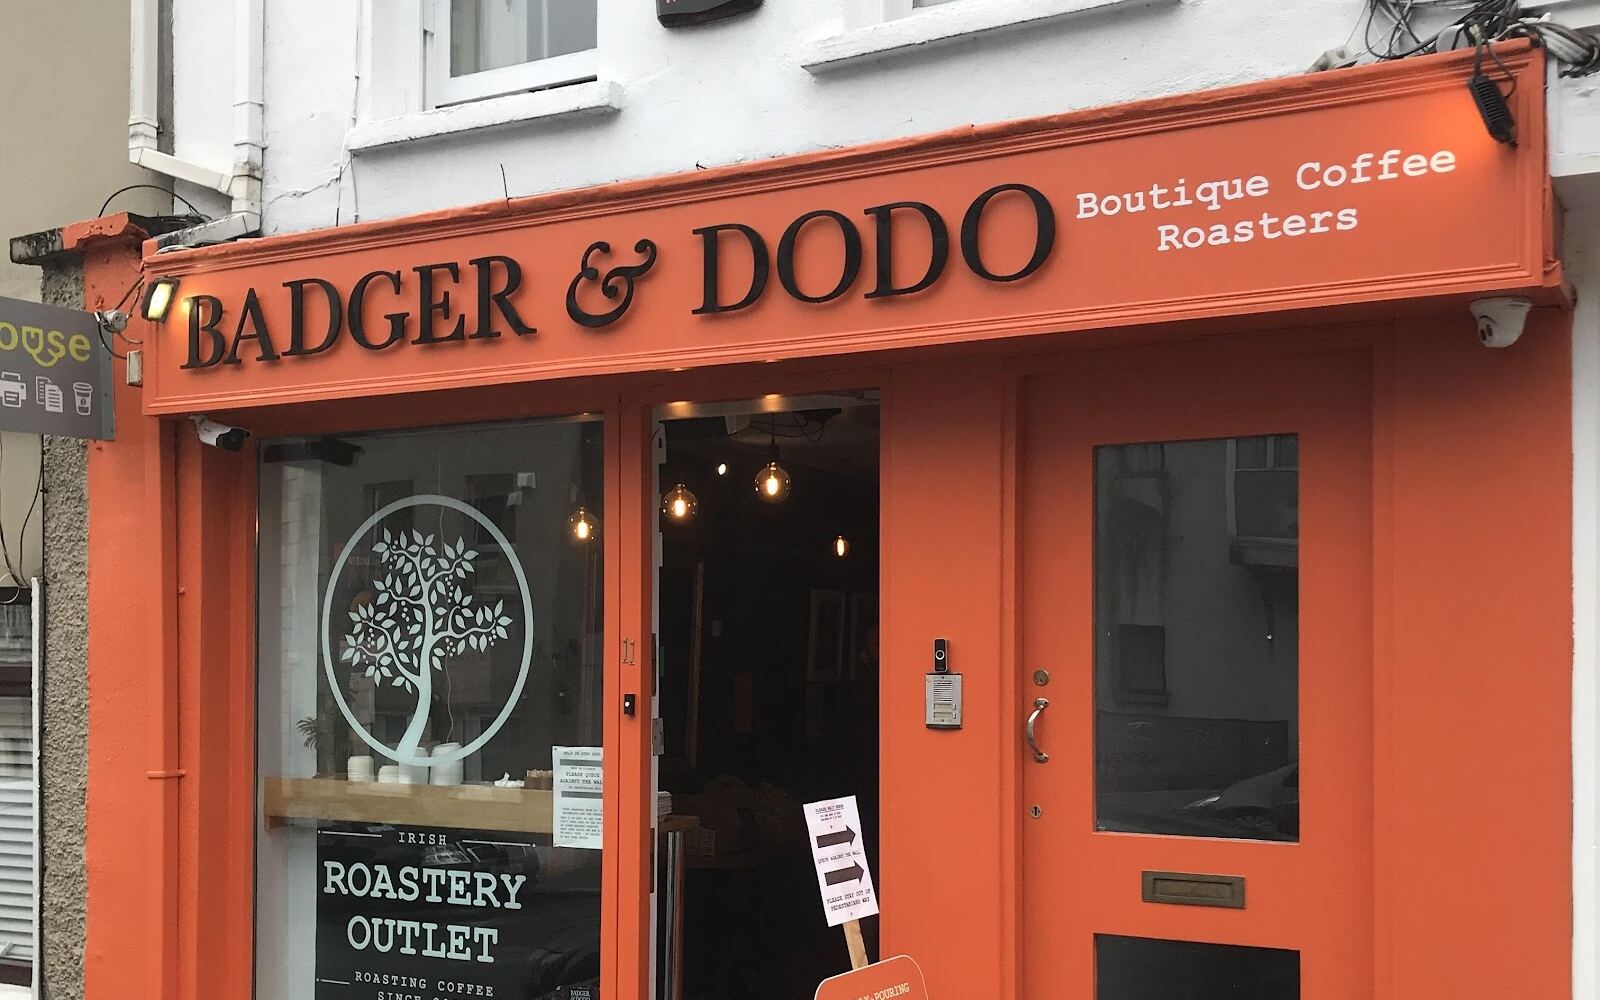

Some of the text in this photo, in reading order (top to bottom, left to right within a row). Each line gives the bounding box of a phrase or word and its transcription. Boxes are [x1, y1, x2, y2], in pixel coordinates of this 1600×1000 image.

[1076, 149, 1457, 219] Boutique Coffee
[1157, 208, 1358, 251] Roasters
[180, 183, 1056, 370] BADGER & DODO
[398, 831, 447, 845] IRISH
[323, 860, 527, 910] ROASTERY
[827, 896, 842, 904] PLEASE
[347, 915, 499, 963] OUTLET
[354, 970, 494, 997] ROASTING COFFEE
